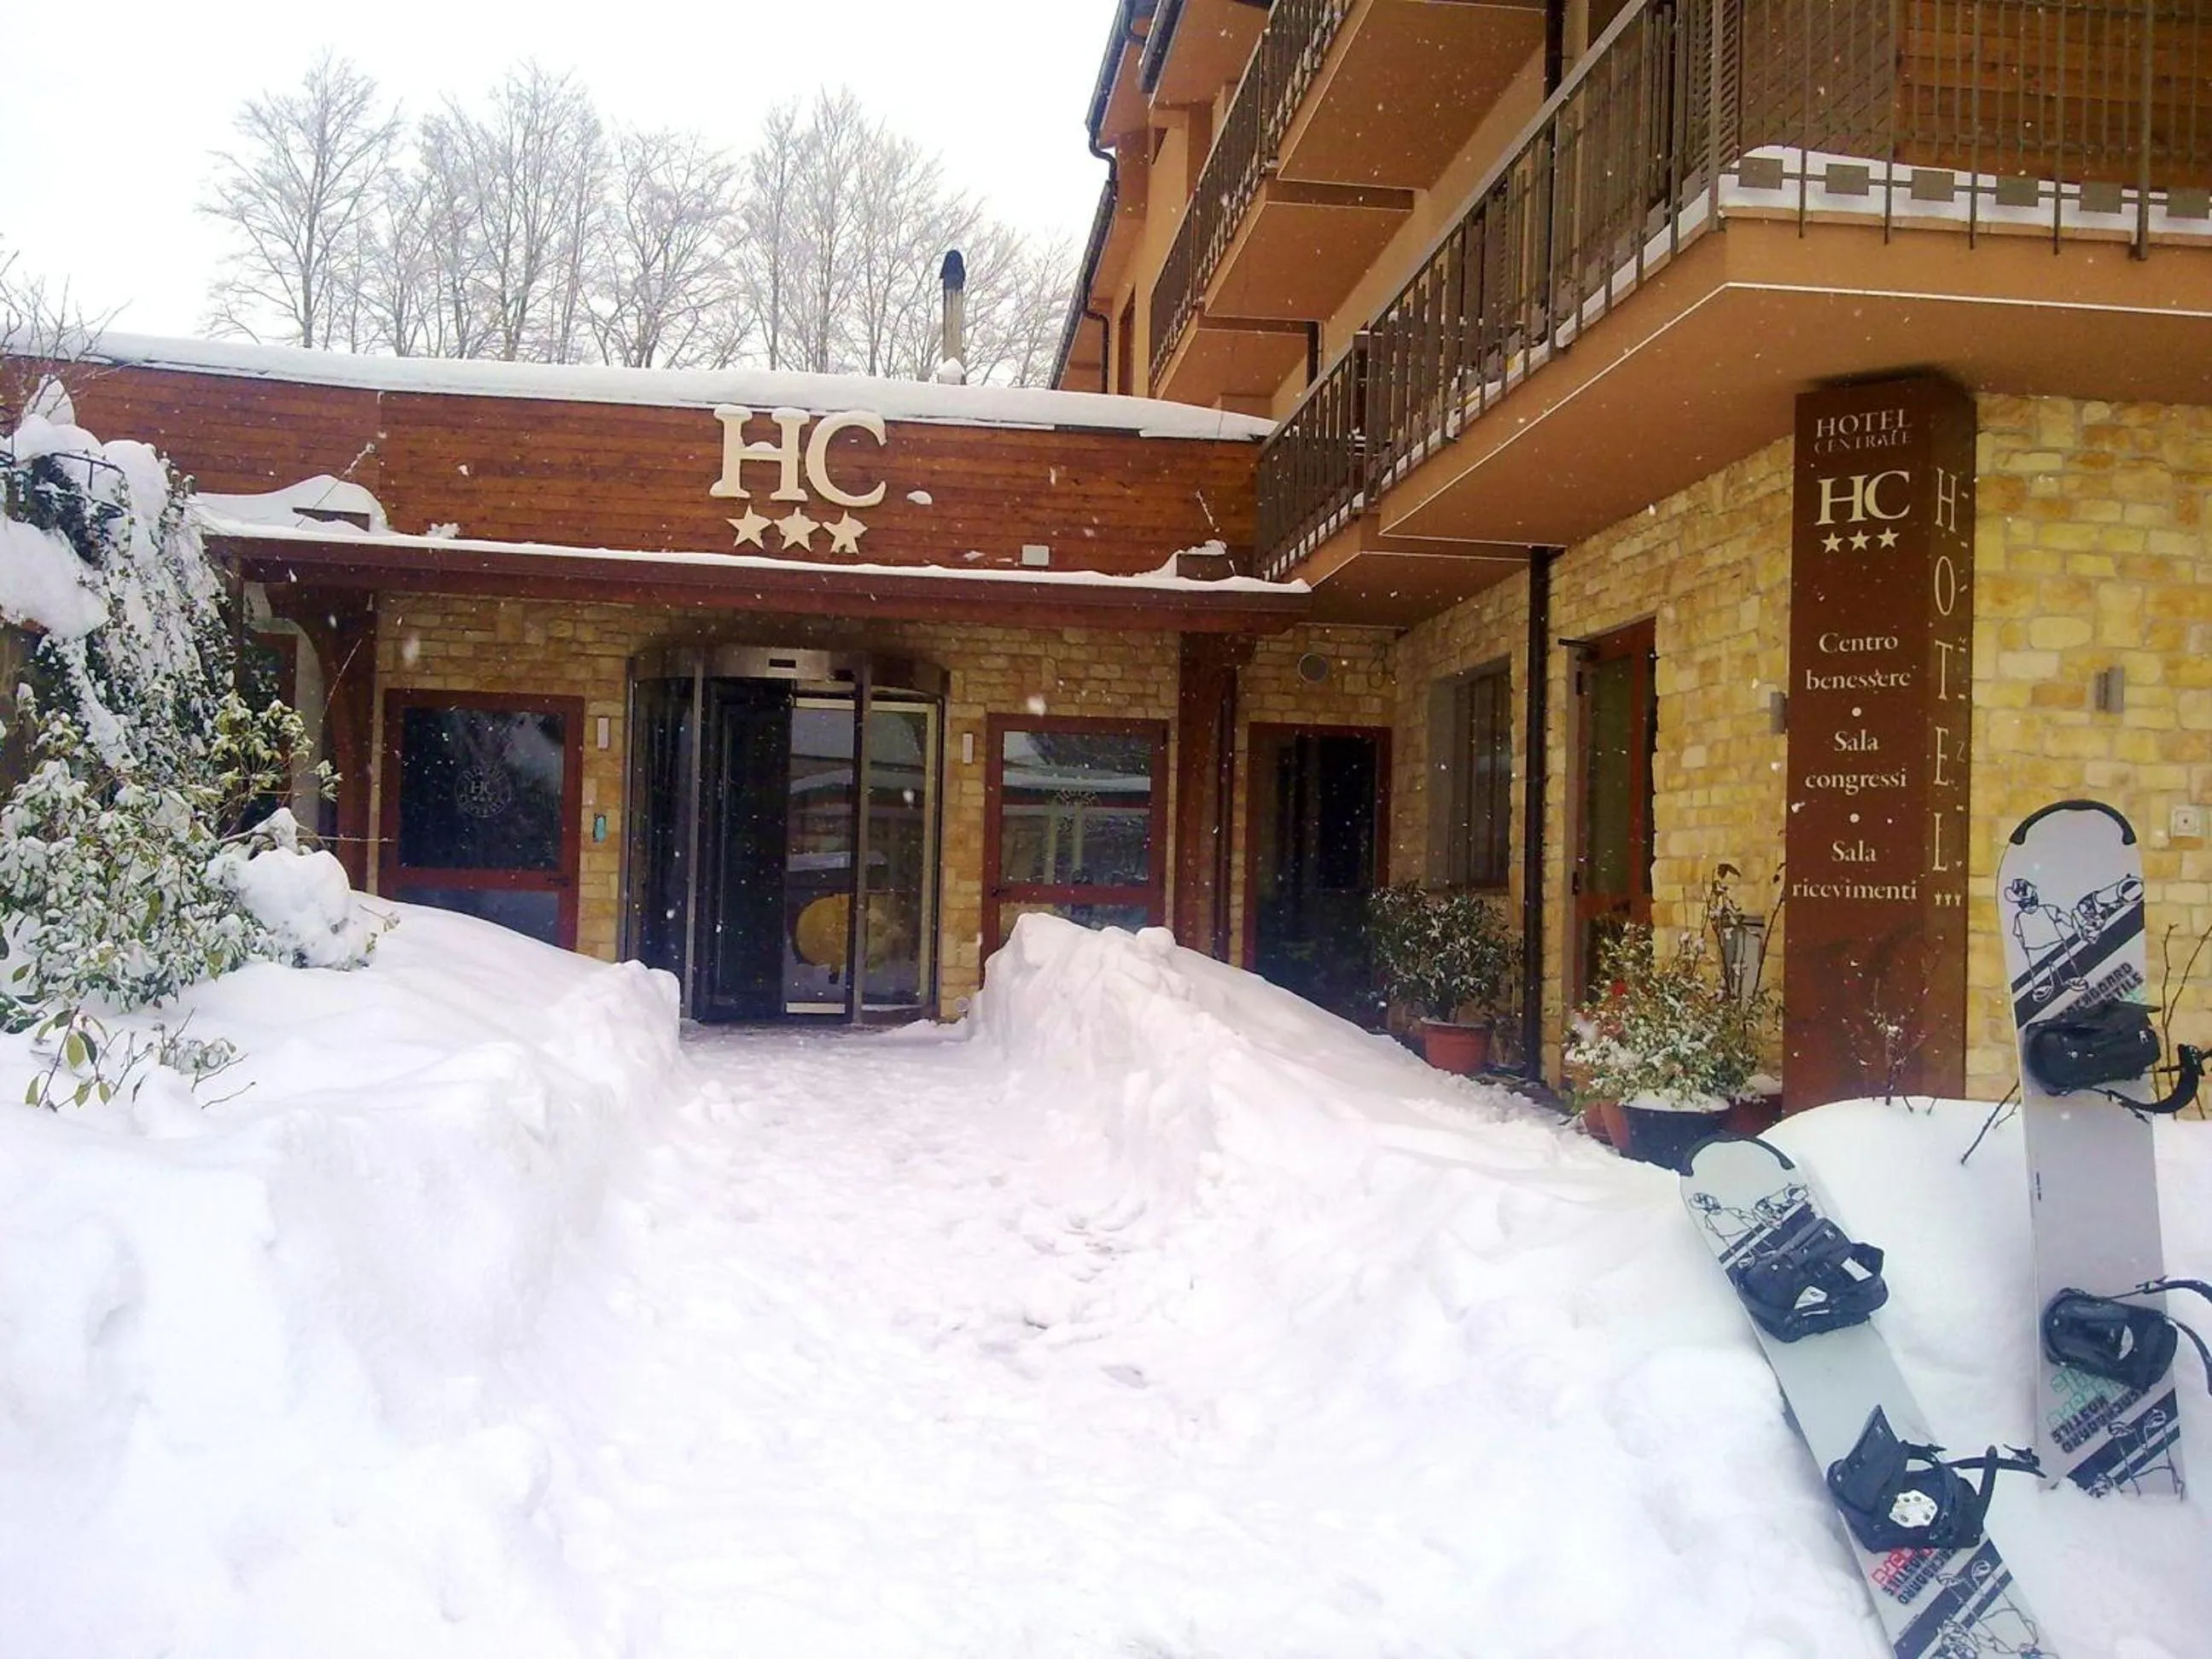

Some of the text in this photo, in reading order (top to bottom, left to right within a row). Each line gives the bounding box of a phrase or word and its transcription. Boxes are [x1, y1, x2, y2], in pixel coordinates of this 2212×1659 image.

[1815, 408, 1912, 438] HOTEL
[1813, 428, 1912, 455] CENTRALE
[709, 404, 888, 507] HC
[1814, 469, 1911, 526] HC
[1819, 632, 1899, 654] Centro
[1805, 668, 1912, 690] benessere
[1933, 467, 1957, 871] HOTEL
[1834, 729, 1879, 752] Sala
[1805, 767, 1907, 795] congressi
[1831, 840, 1877, 862] Sala
[1792, 877, 1918, 901] ricevimenti
